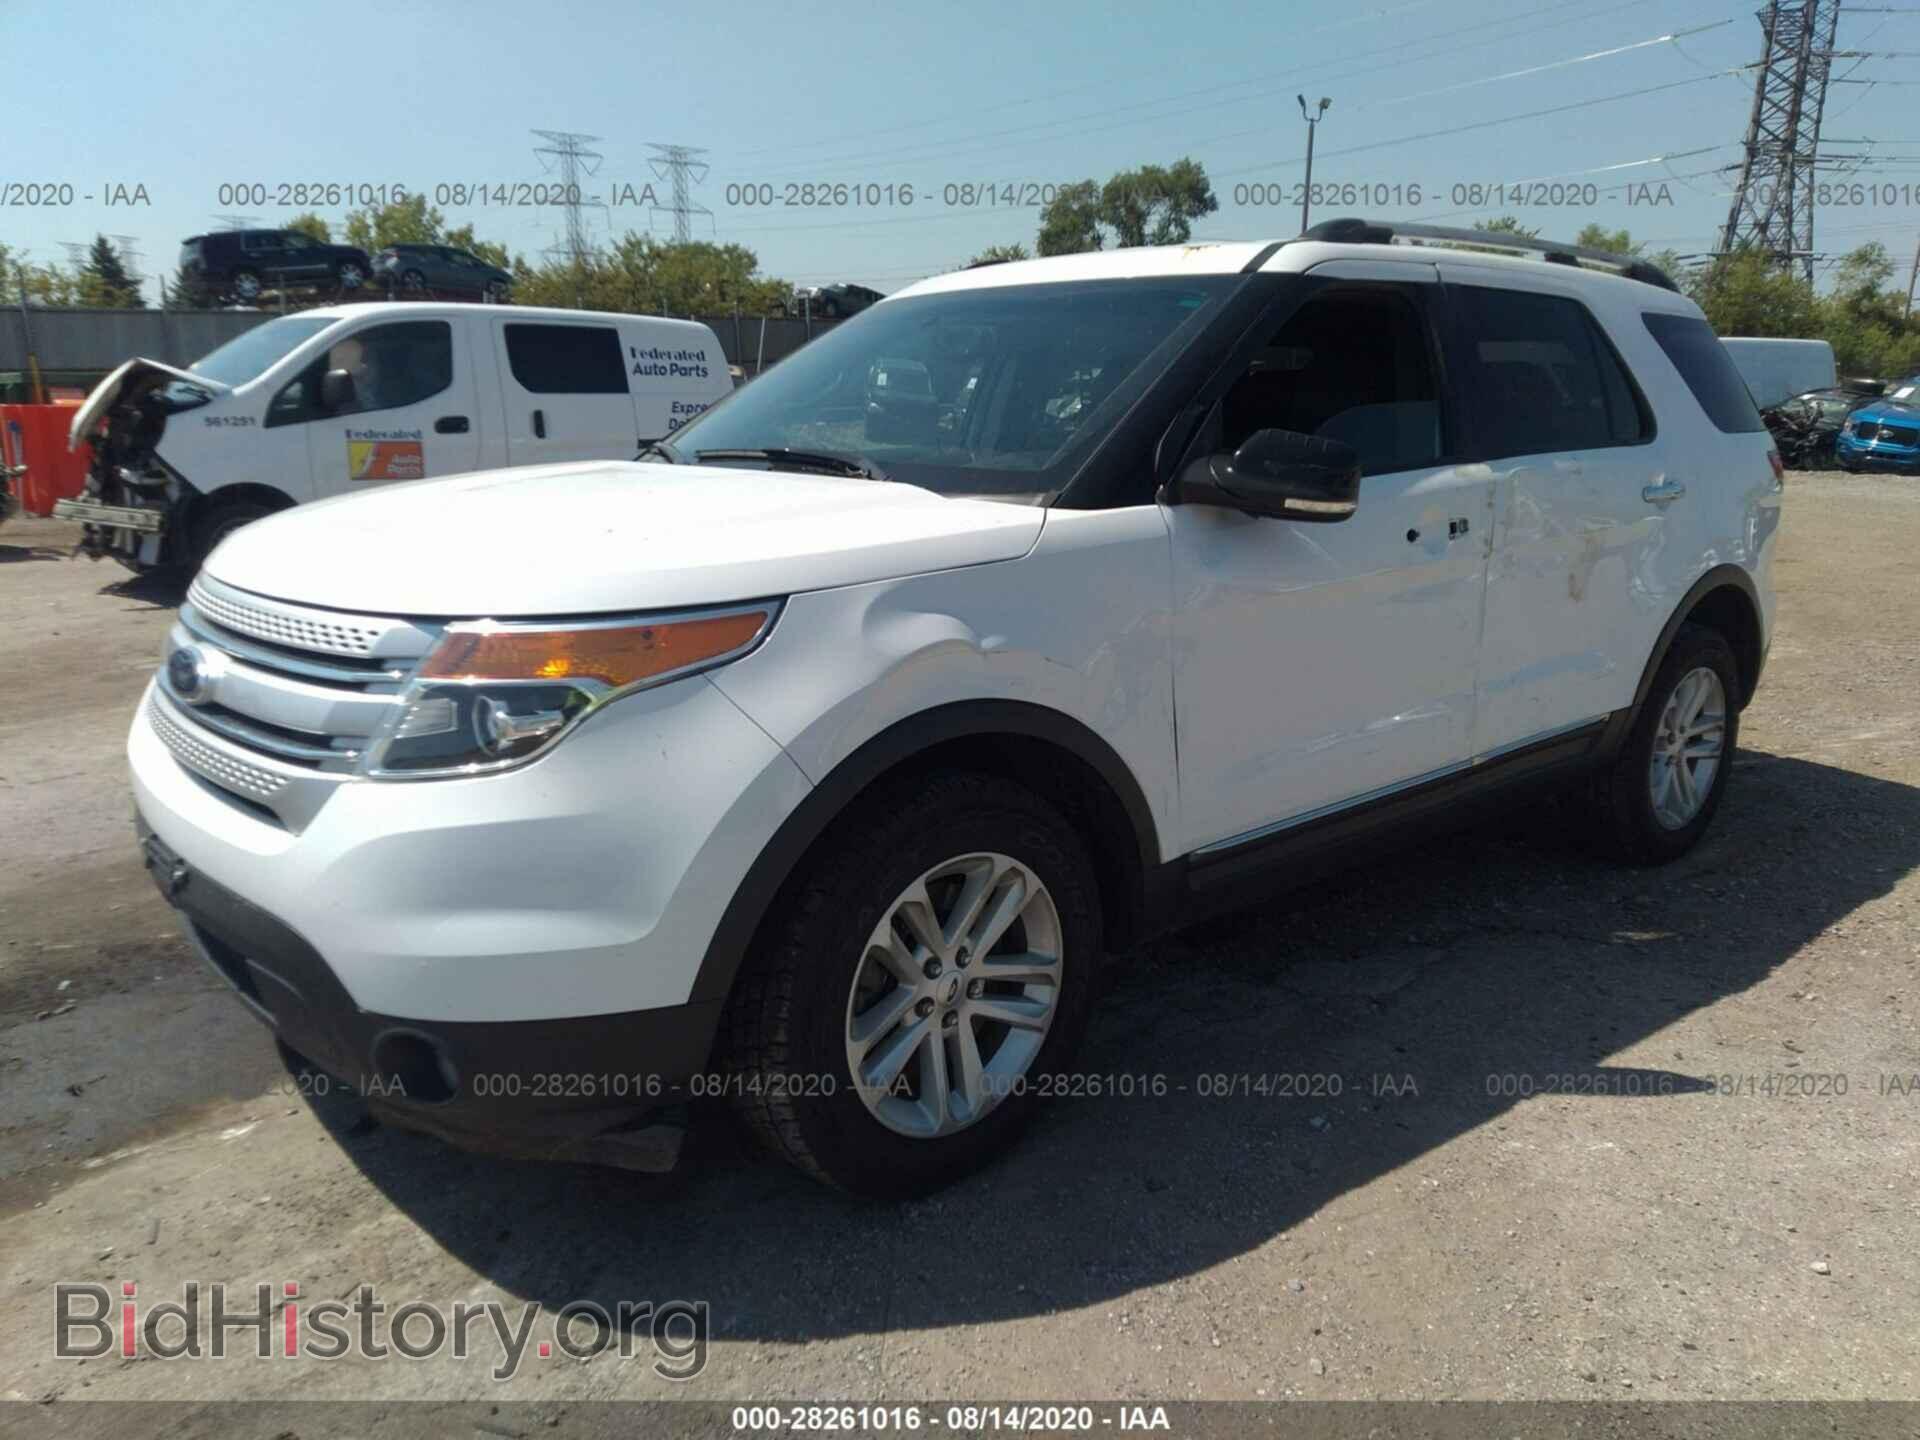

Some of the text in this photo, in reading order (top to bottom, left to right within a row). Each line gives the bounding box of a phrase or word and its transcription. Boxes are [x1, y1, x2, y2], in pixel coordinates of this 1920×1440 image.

[630, 346, 706, 362] Federated
[632, 362, 709, 378] Auto Parts
